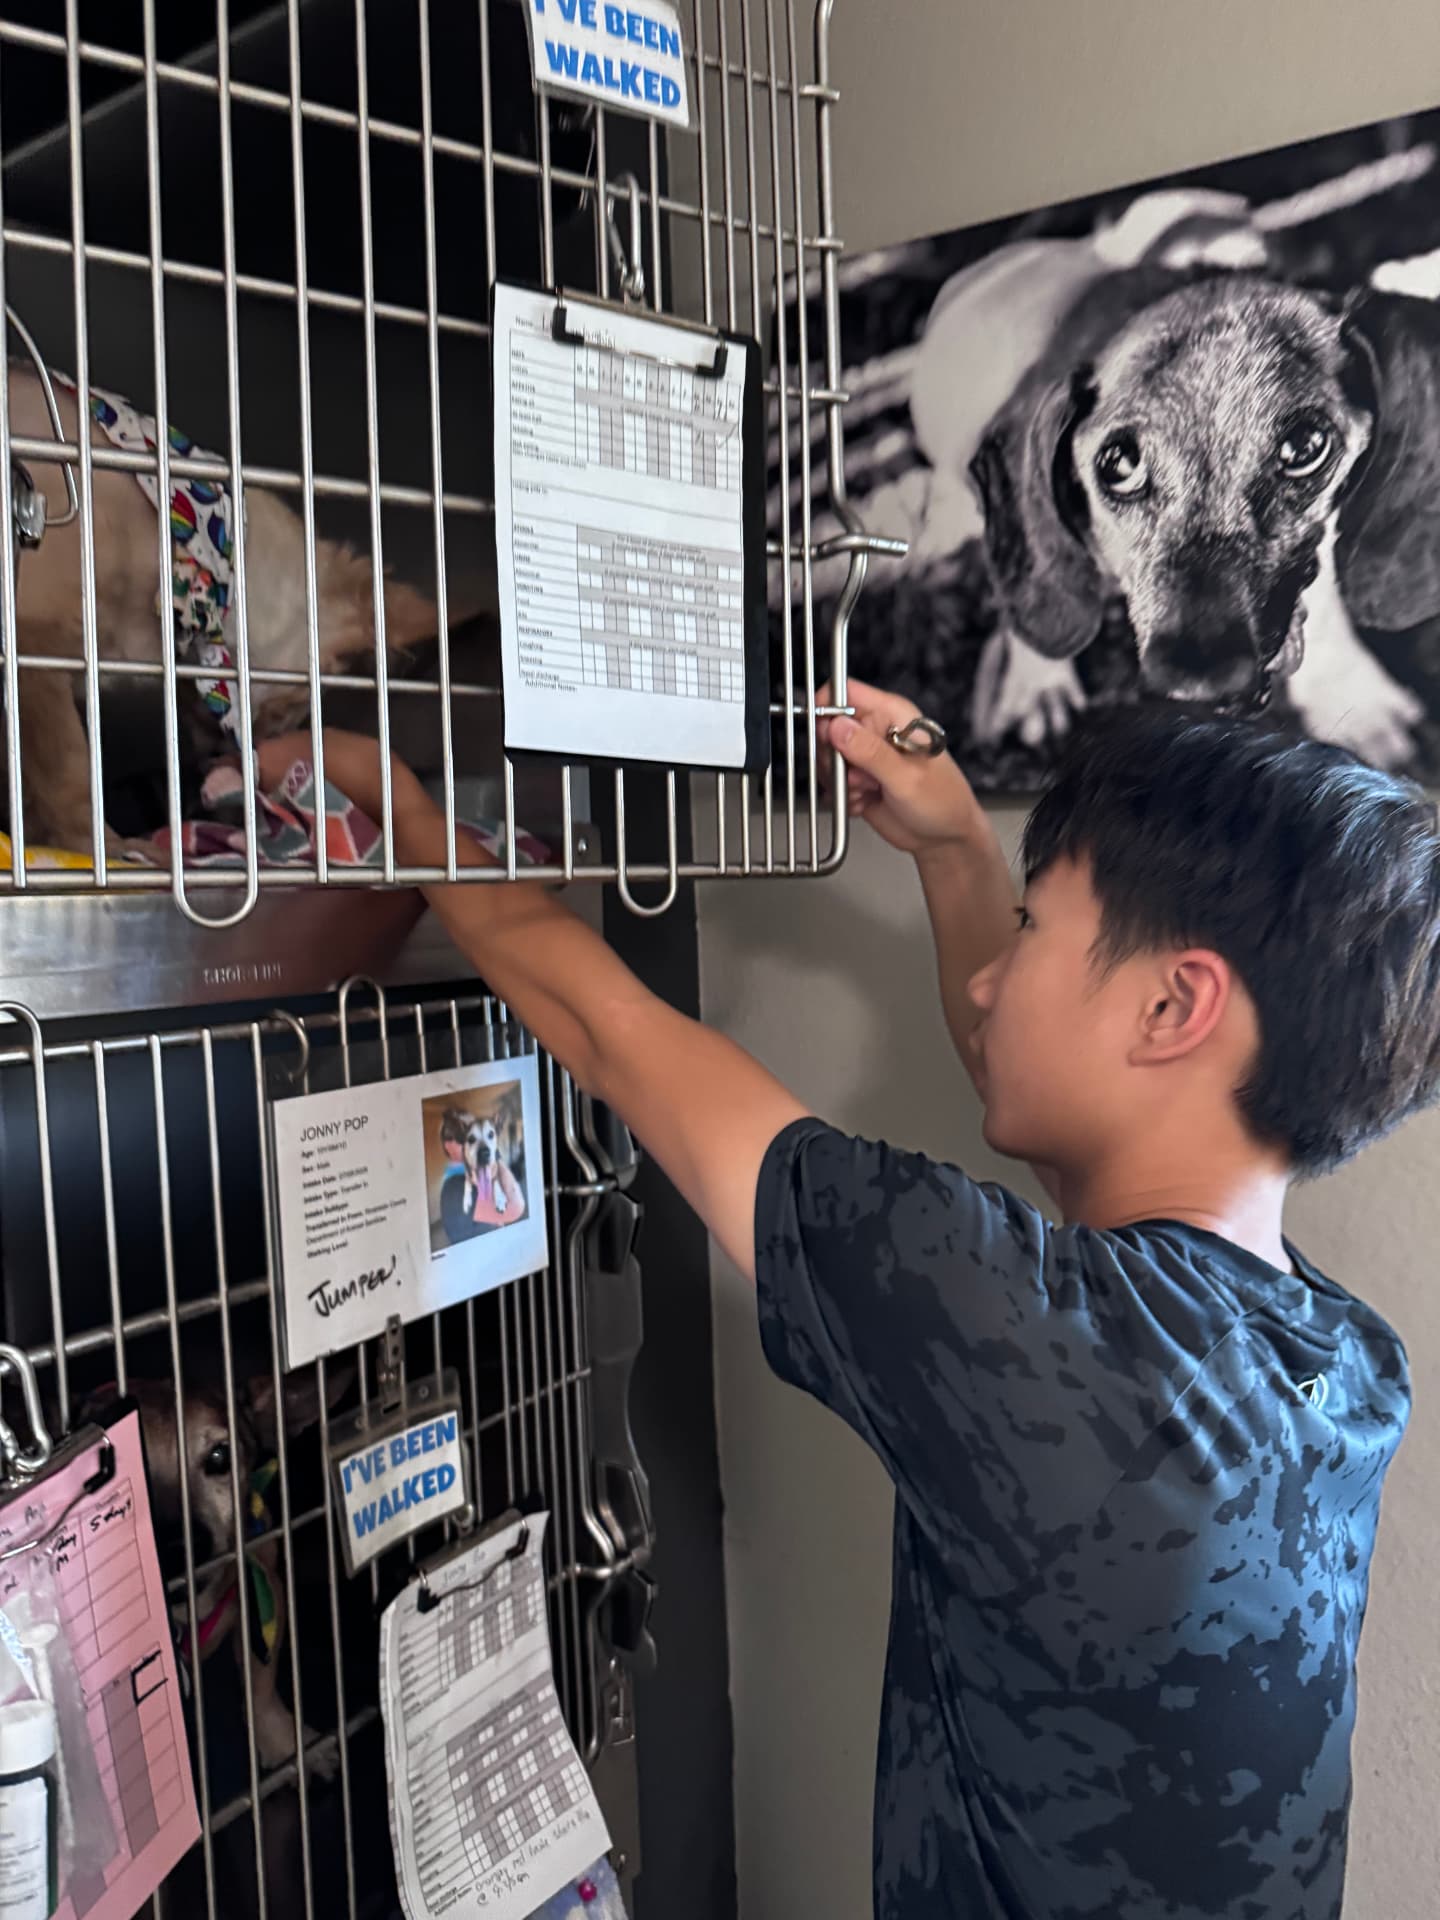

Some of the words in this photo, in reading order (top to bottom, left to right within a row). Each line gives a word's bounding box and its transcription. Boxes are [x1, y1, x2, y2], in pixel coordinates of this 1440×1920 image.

[604, 3, 680, 59] BEEN
[544, 39, 681, 108] WALKED
[300, 1121, 341, 1142] JONNY
[344, 1115, 369, 1133] POP
[342, 1446, 386, 1495] I'VE
[389, 1416, 456, 1467] BEEN
[353, 1463, 456, 1539] WALKED
